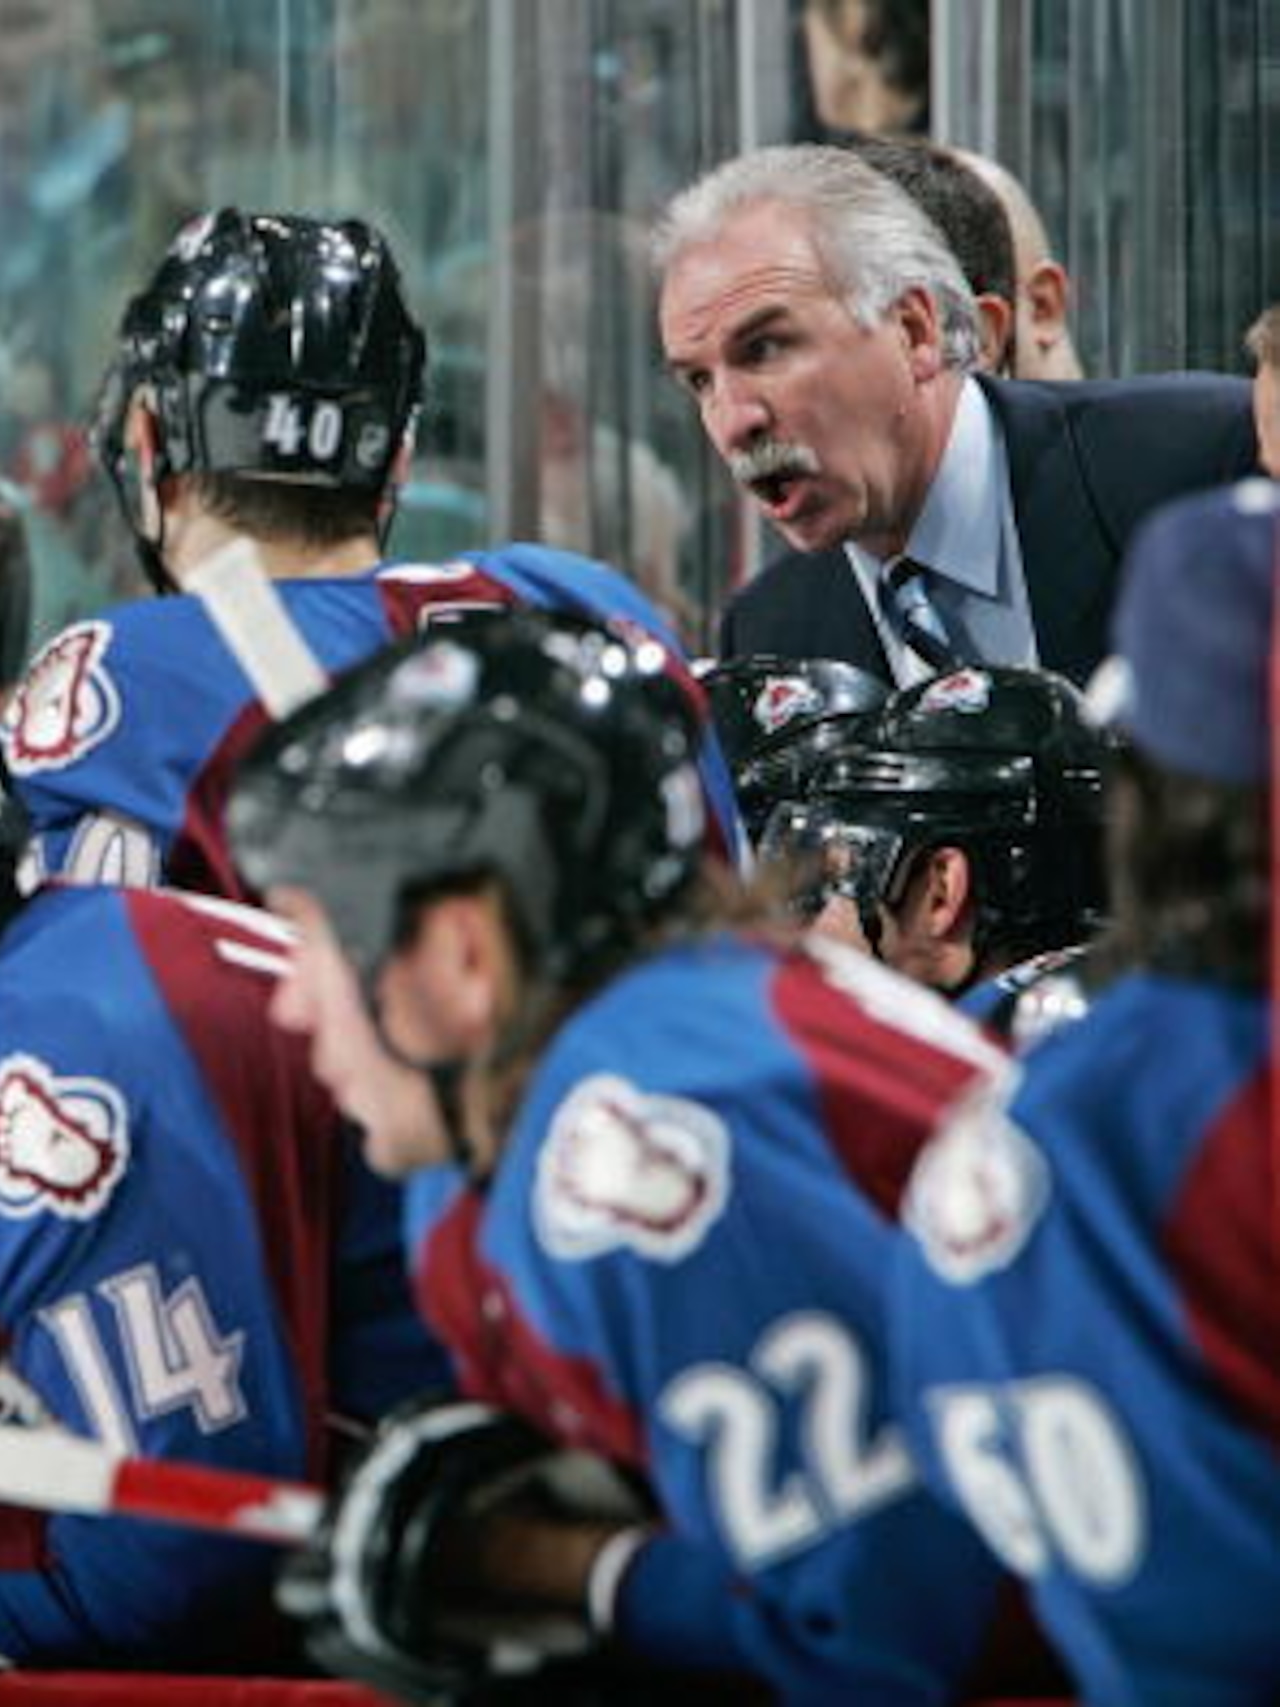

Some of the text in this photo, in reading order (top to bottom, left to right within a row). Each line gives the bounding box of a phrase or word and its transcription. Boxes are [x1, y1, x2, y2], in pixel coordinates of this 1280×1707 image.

[263, 395, 342, 459] 40
[36, 1261, 247, 1458] 14
[658, 1310, 913, 1572] 22
